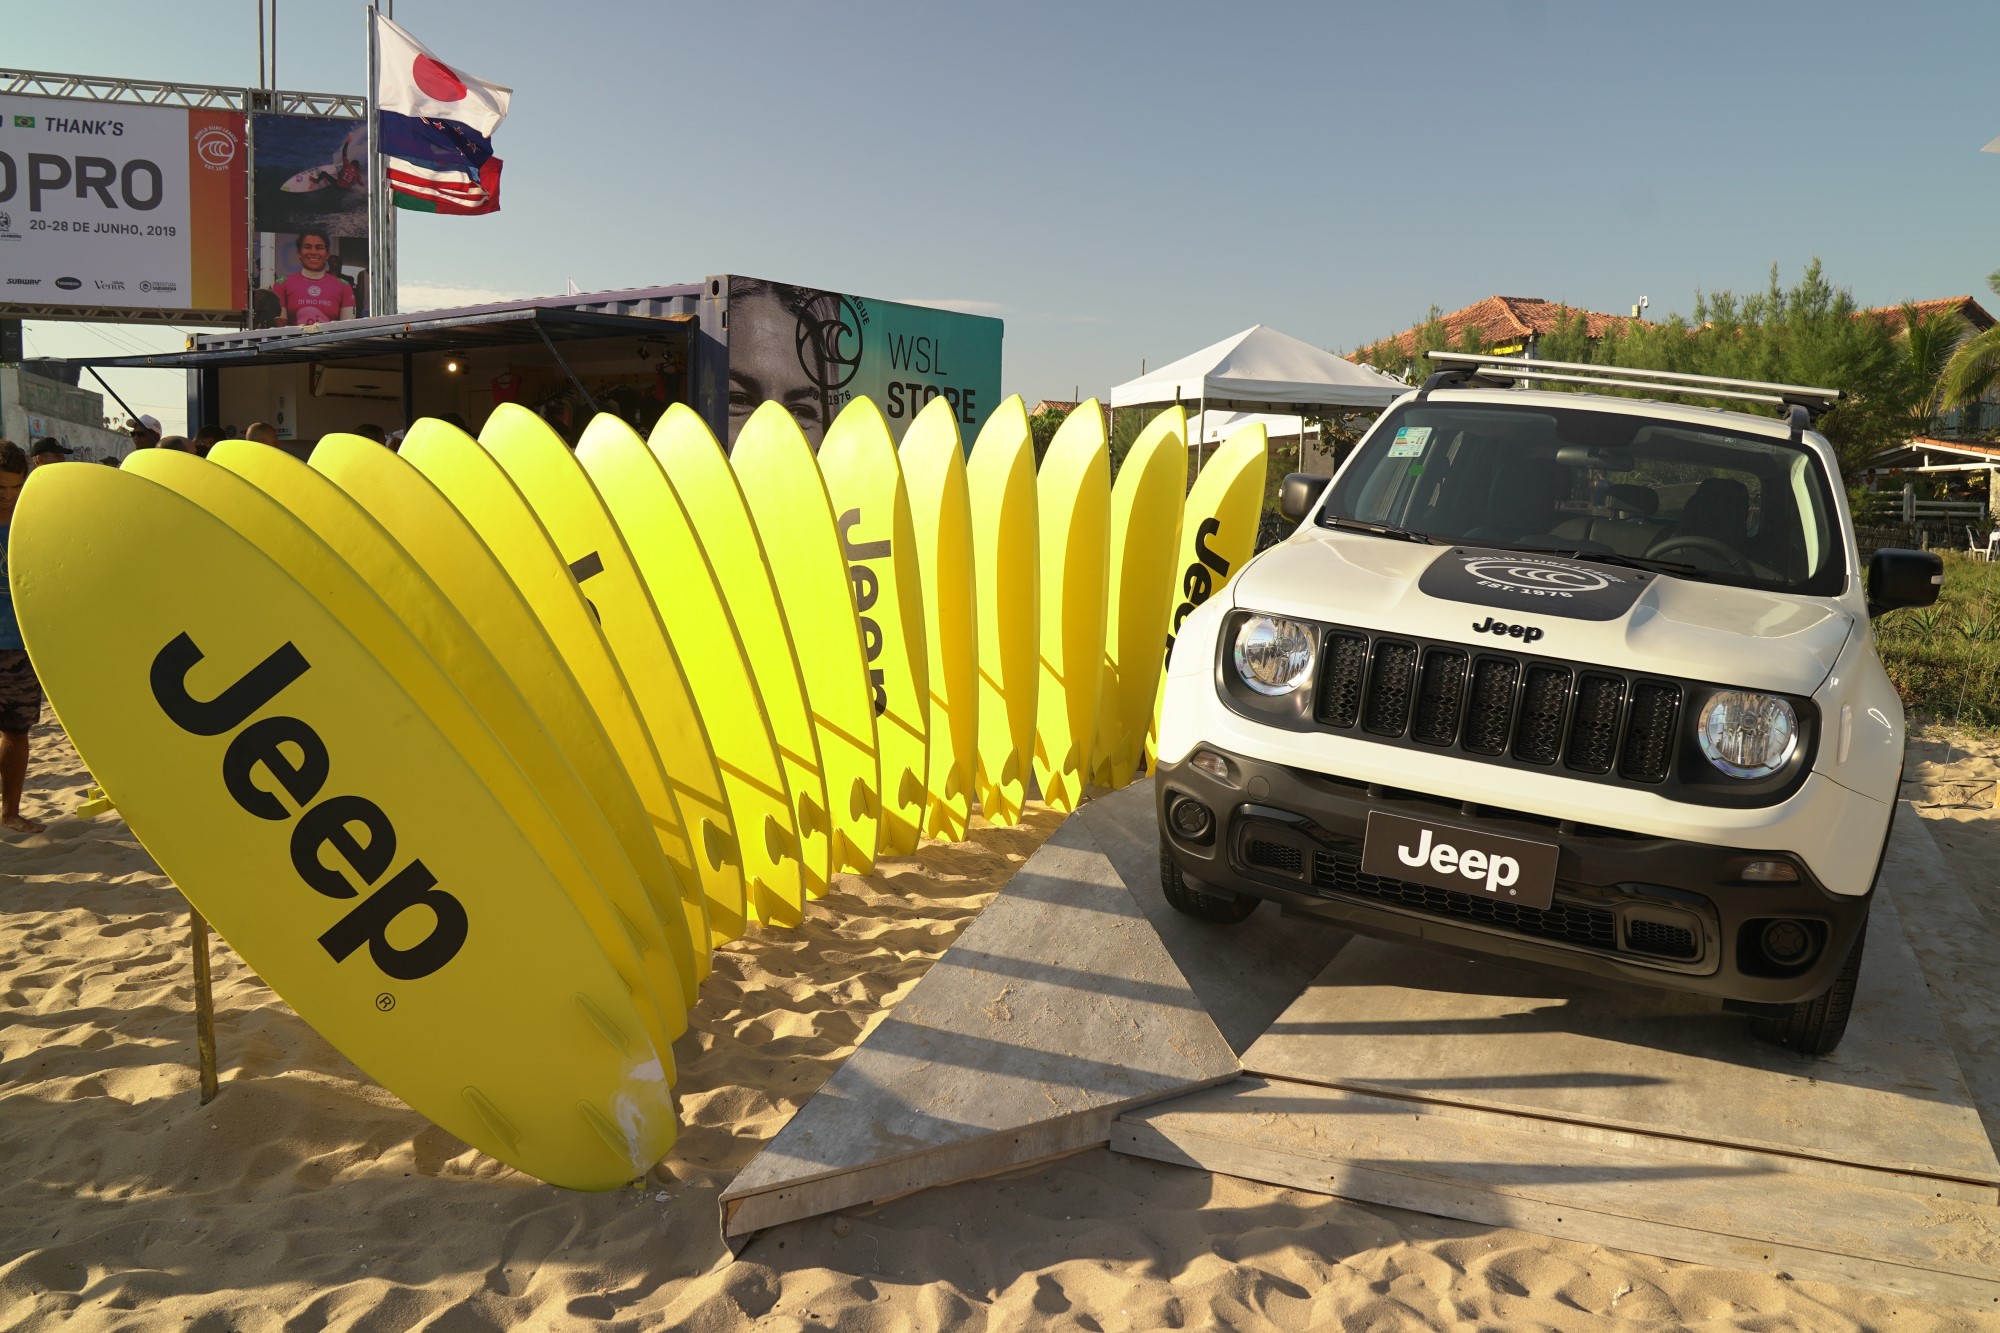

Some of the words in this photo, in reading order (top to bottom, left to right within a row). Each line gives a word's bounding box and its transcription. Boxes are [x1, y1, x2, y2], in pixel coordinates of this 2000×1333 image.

[45, 117, 124, 136] THANK'S
[28, 153, 163, 212] PRO
[30, 220, 69, 231] 20-28
[73, 222, 90, 233] DE
[94, 223, 143, 236] JUNHO,
[147, 226, 177, 237] 2019
[94, 280, 126, 290] Venus
[888, 332, 947, 376] WSL
[828, 389, 851, 406] 1976
[1472, 617, 1544, 644] Jeep
[150, 631, 468, 980] Jeep
[1398, 829, 1520, 892] Jeep
